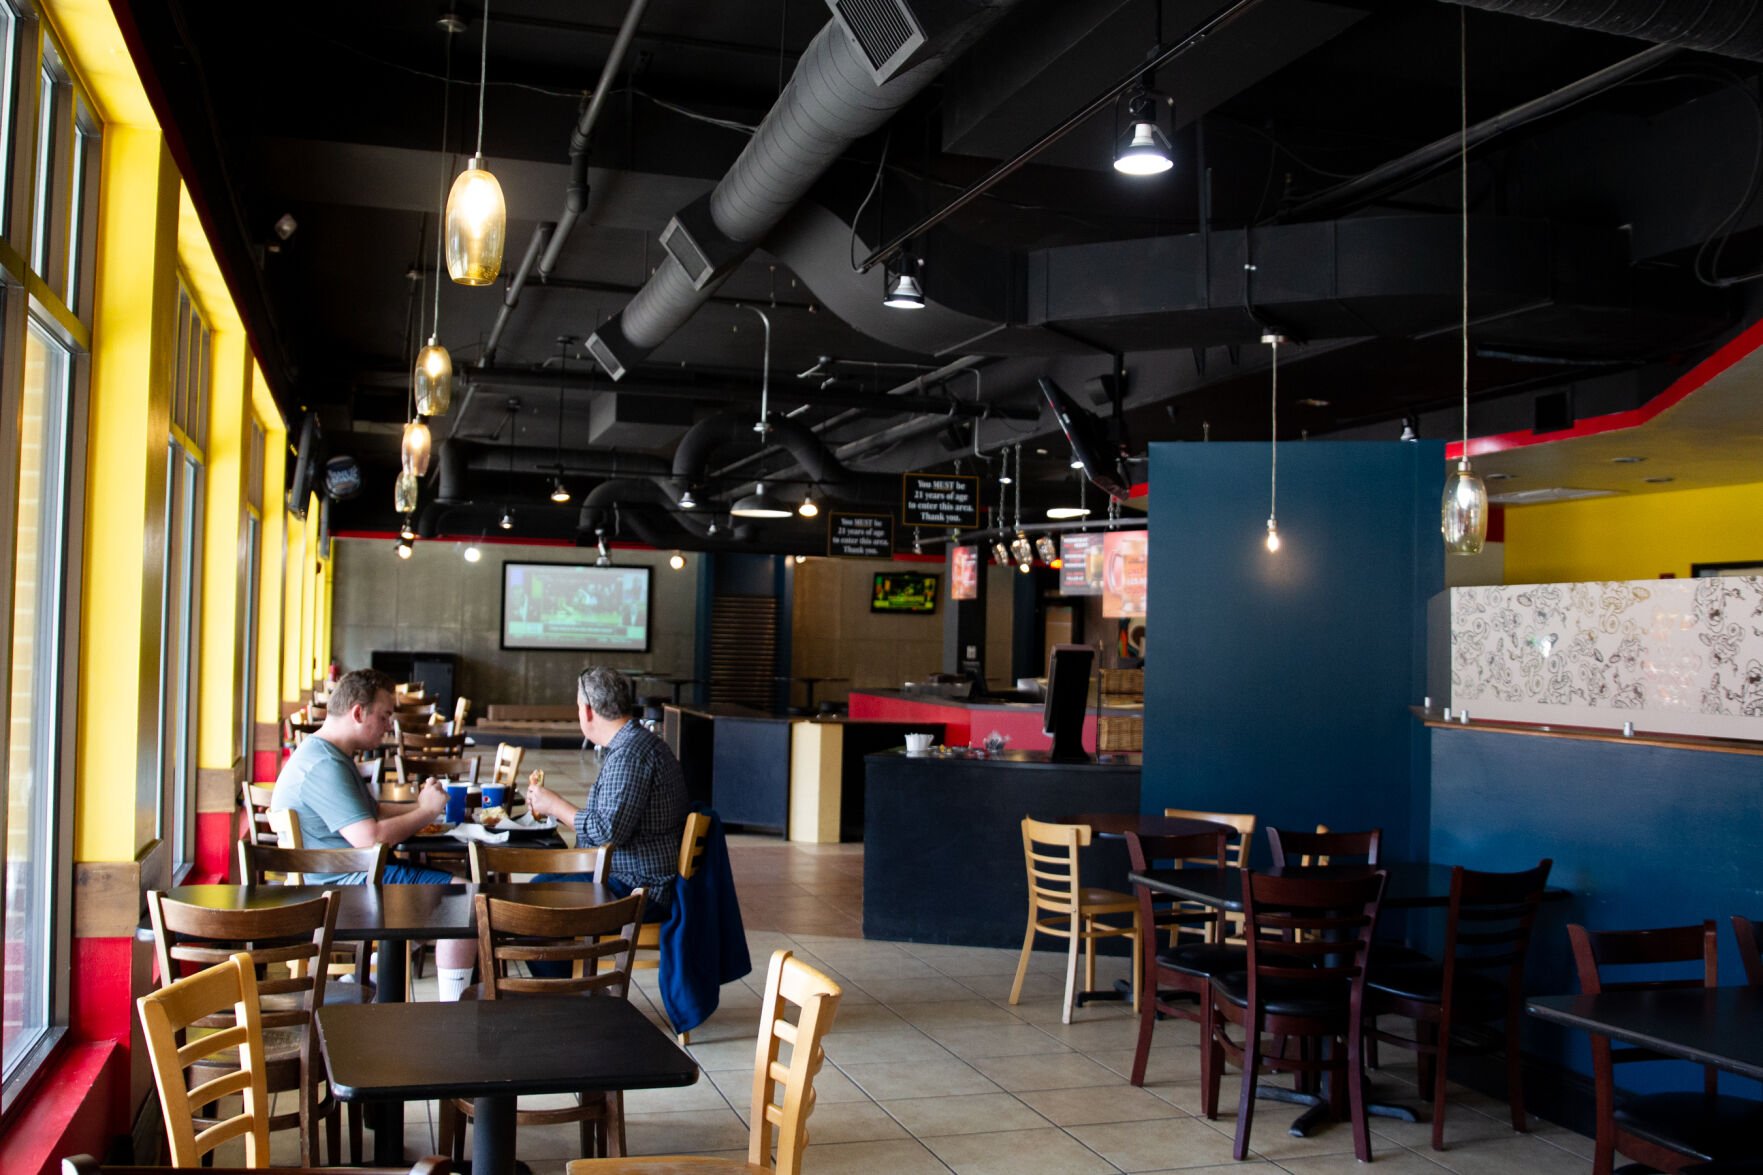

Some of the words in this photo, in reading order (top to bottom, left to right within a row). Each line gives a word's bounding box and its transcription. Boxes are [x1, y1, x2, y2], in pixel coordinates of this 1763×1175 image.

[918, 480, 932, 488] You
[933, 480, 954, 489] MUST
[956, 481, 965, 490] be
[946, 492, 954, 500] of
[955, 494, 968, 502] age
[939, 502, 954, 511] this
[920, 512, 944, 521] Thank
[946, 515, 961, 523] you.
